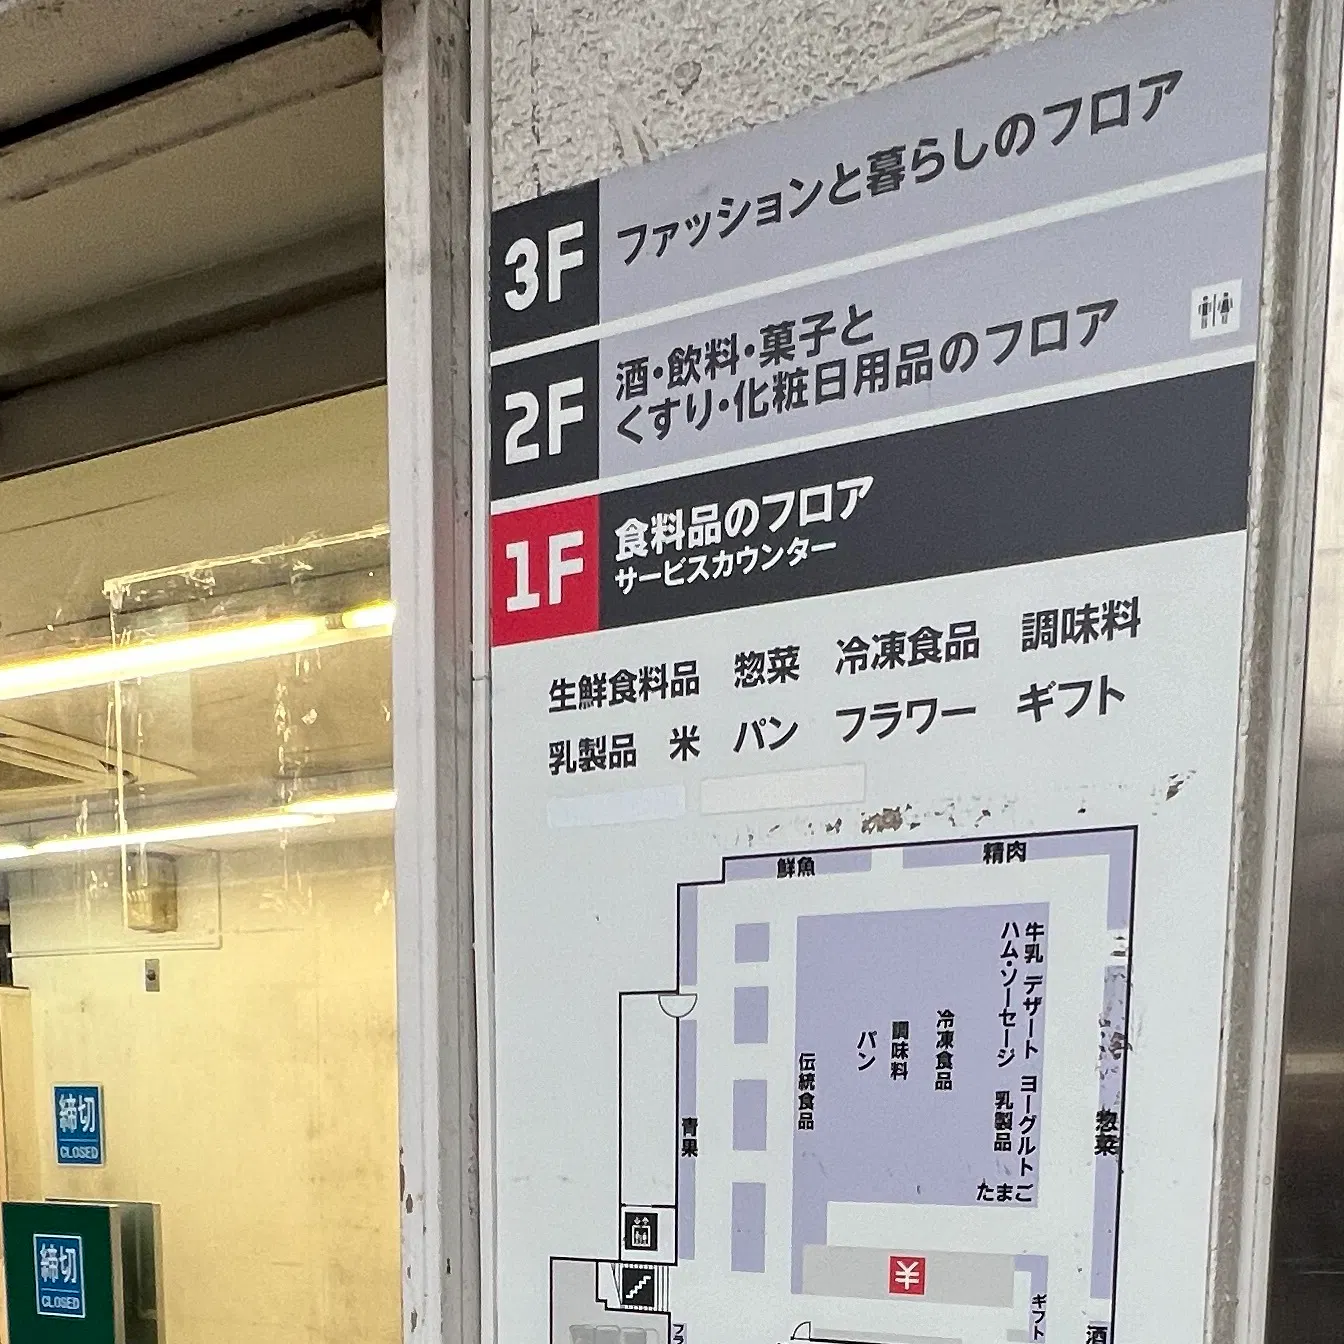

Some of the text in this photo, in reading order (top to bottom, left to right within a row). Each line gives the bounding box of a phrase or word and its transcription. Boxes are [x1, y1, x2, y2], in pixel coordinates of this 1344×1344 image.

[616, 68, 1184, 267] ファッションと暮らしのフロア
[504, 220, 587, 312] 3F
[616, 304, 876, 403] 酒・飲料・菓子と
[616, 296, 1120, 445] くすり・化粧日用品のフロア
[504, 377, 587, 466] 2F
[615, 475, 875, 561] 食料品のフロア
[504, 530, 586, 613] 1F
[615, 537, 837, 597] サービスカウンター
[548, 596, 1141, 714] 生鮮食料品 惣菜 冷凍食品 調味料
[548, 673, 1126, 776] 乳製品 米 パン フラワー ギフト
[776, 856, 816, 879] 鮮魚
[982, 841, 1027, 865] 精肉
[856, 1030, 878, 1072] パン
[890, 1020, 910, 1081] 調味料
[934, 1008, 955, 1091] 冷凍食品
[994, 921, 1020, 1152] ハム・ソーセージ 乳製品
[1017, 922, 1045, 1176] 牛乳 デザート ヨーグルト
[58, 1093, 96, 1134] 締切
[797, 1052, 816, 1131] 伝統食品
[59, 1146, 99, 1160] CLOSED
[681, 1116, 699, 1158] 青果
[1093, 1108, 1119, 1157] 惣菜
[975, 1181, 1033, 1203] たまご
[39, 1243, 77, 1284] 締切
[41, 1295, 80, 1310] CLOSED
[1031, 1293, 1047, 1342] ギフト
